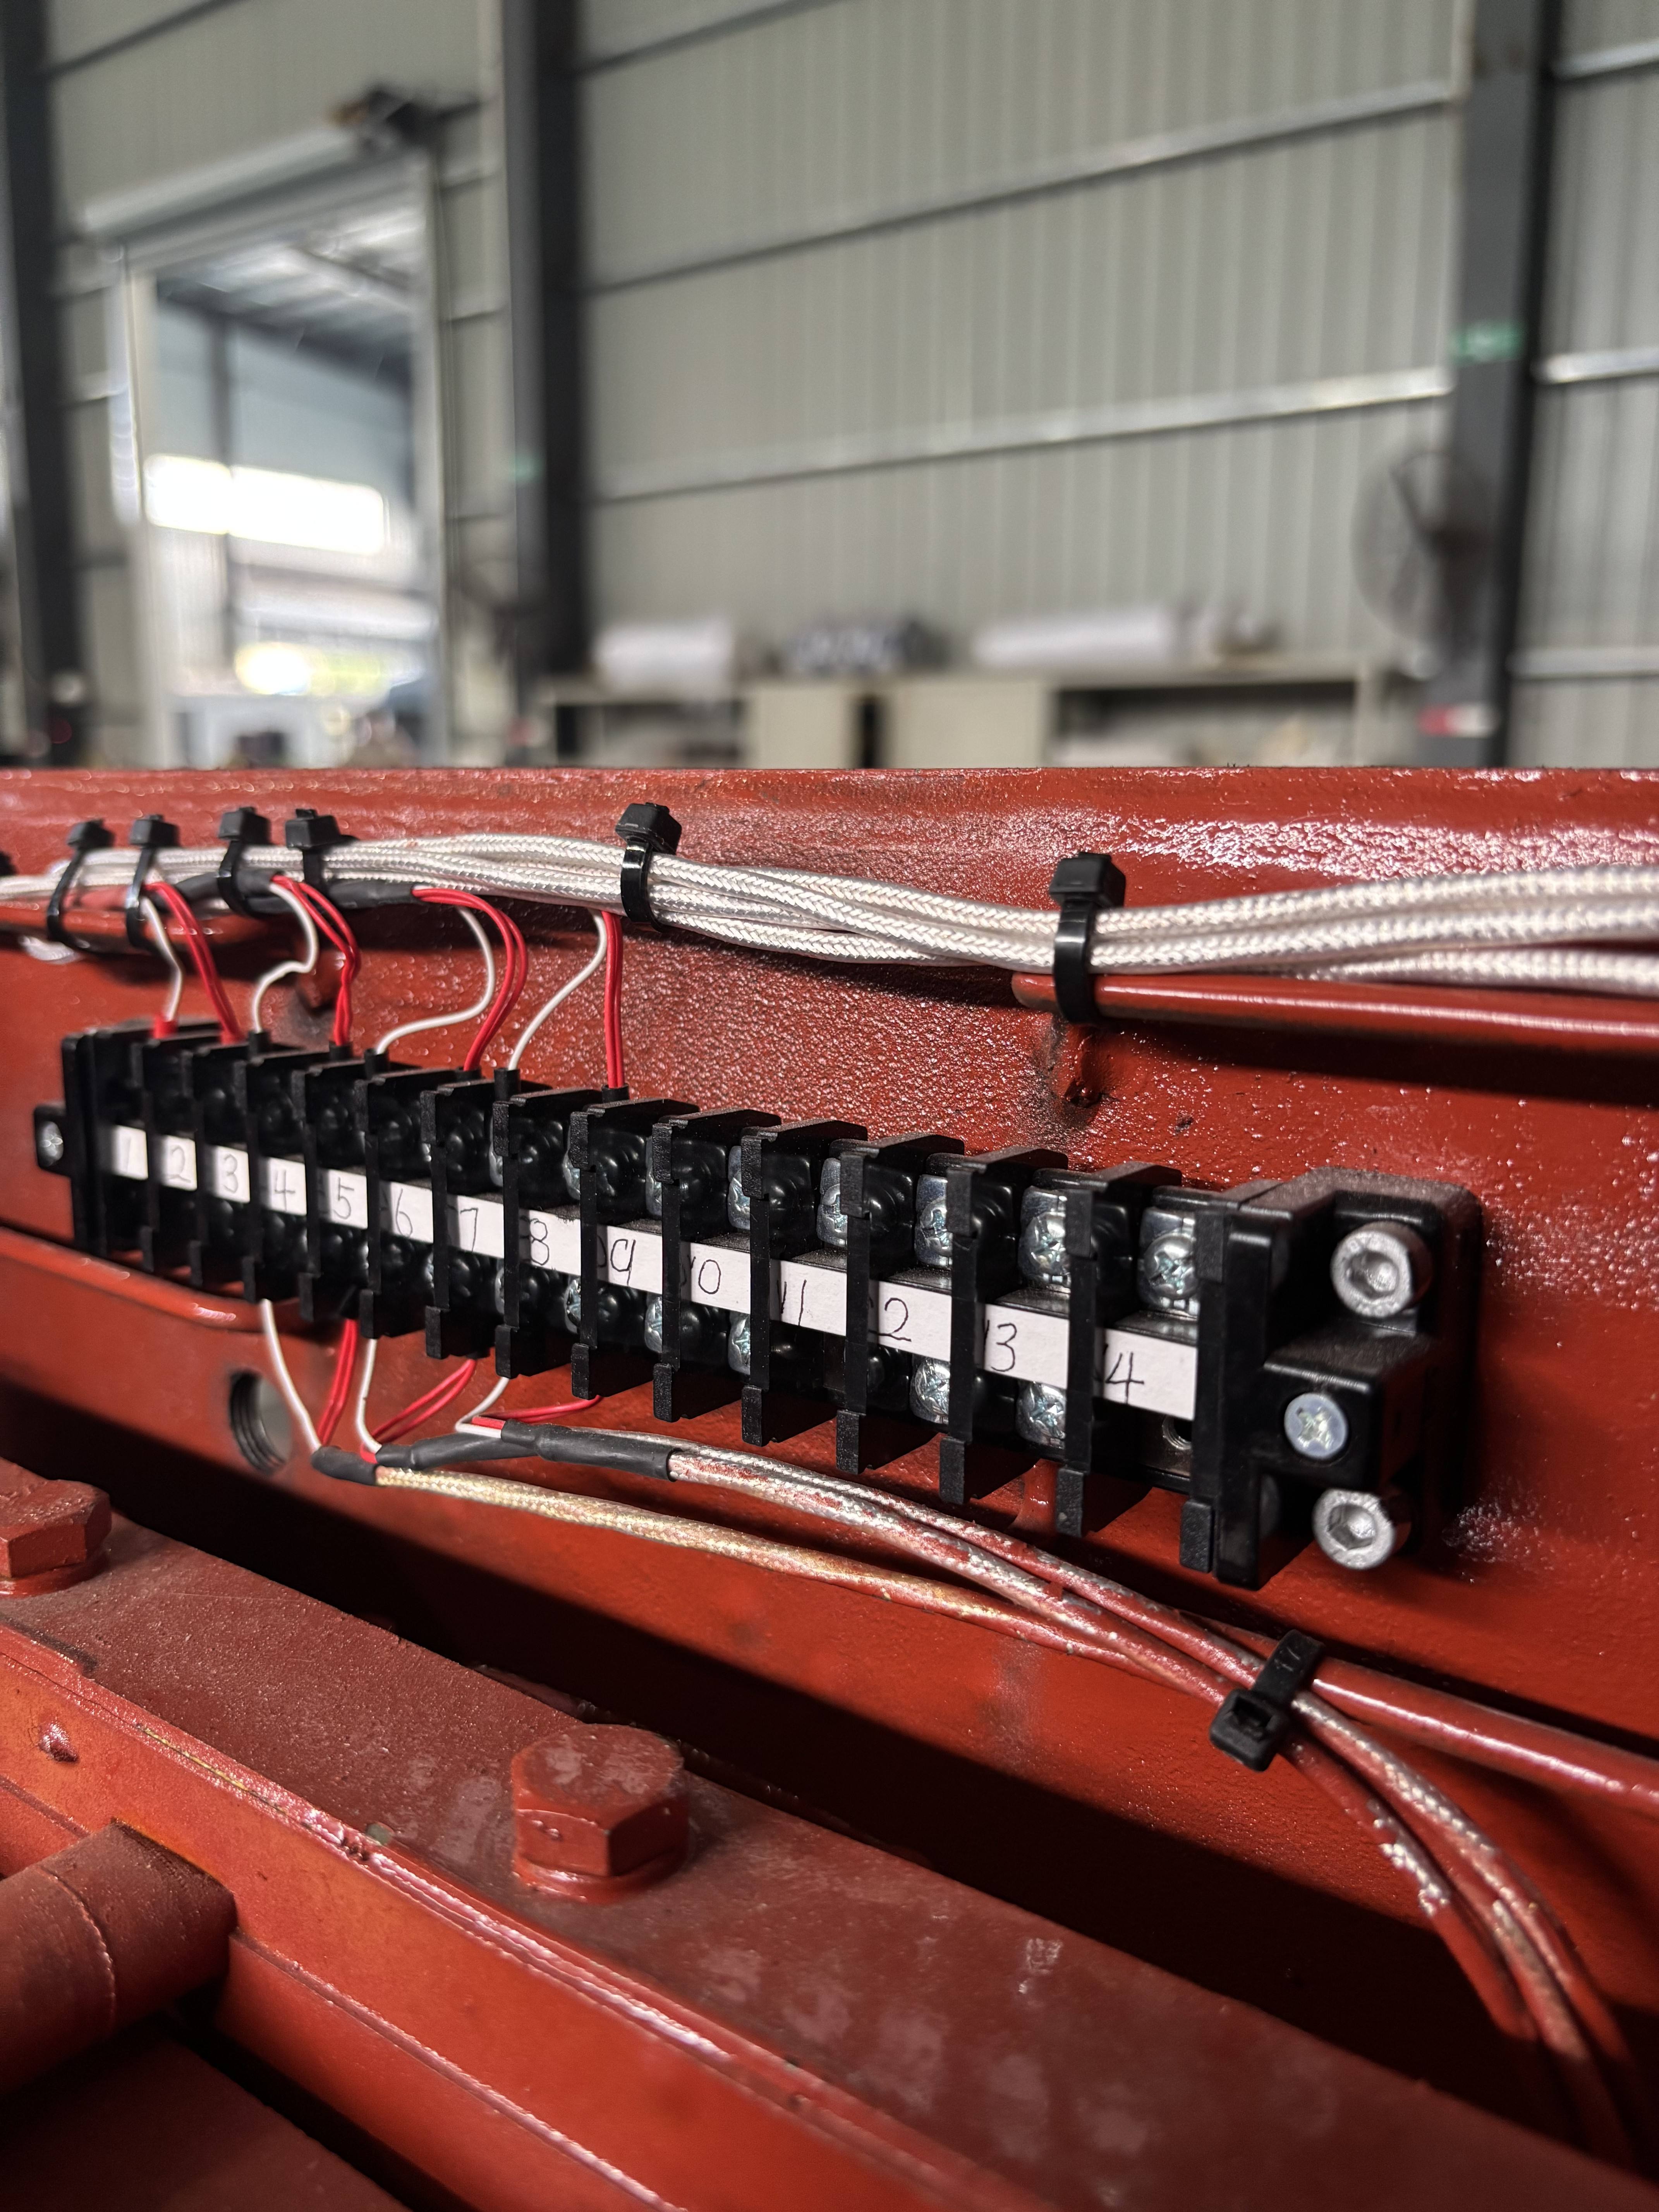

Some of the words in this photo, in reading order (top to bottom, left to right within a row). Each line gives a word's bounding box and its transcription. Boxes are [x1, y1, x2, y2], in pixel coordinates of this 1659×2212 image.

[168, 1144, 192, 1183] 2
[223, 1154, 239, 1194] 3
[274, 1169, 295, 1212] 4
[332, 1176, 355, 1219] 5
[395, 1188, 413, 1239] 6
[460, 1207, 479, 1252] 7
[529, 1218, 550, 1266] 8
[610, 1238, 636, 1286] 9
